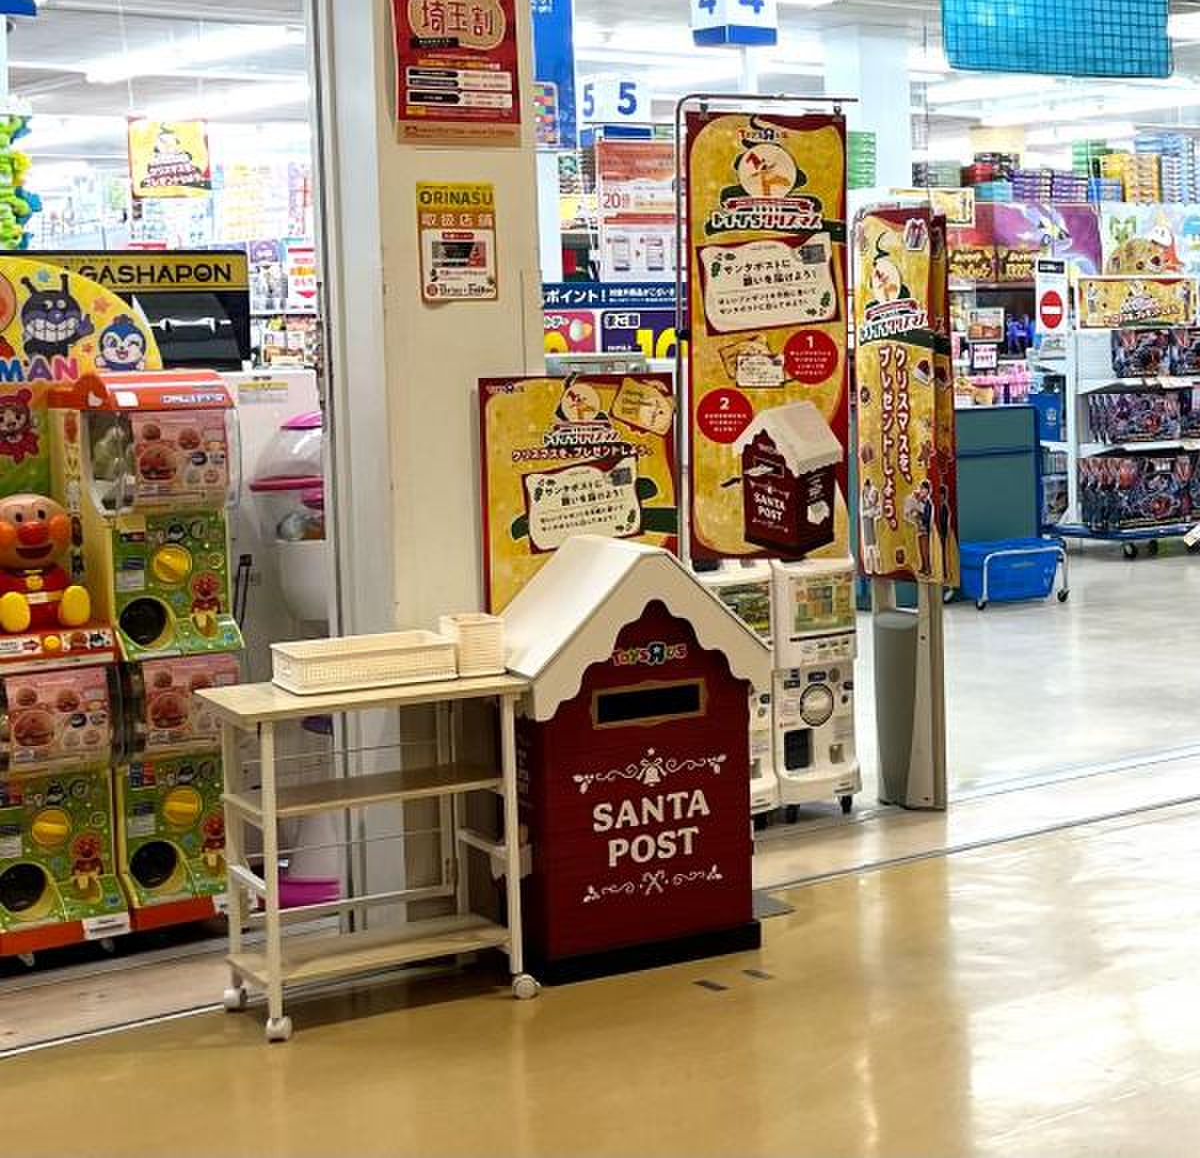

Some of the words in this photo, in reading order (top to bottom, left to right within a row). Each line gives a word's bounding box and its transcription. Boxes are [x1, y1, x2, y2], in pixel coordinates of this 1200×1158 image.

[421, 0, 493, 35] 埼玉割
[583, 84, 595, 117] 5
[617, 82, 637, 115] 5
[420, 190, 494, 204] ORINASU
[719, 397, 730, 410] 2
[895, 348, 913, 487] クリスマスを、
[879, 348, 898, 532] プレゼントしよう。
[593, 789, 711, 832] SANTA
[608, 827, 700, 868] POST
